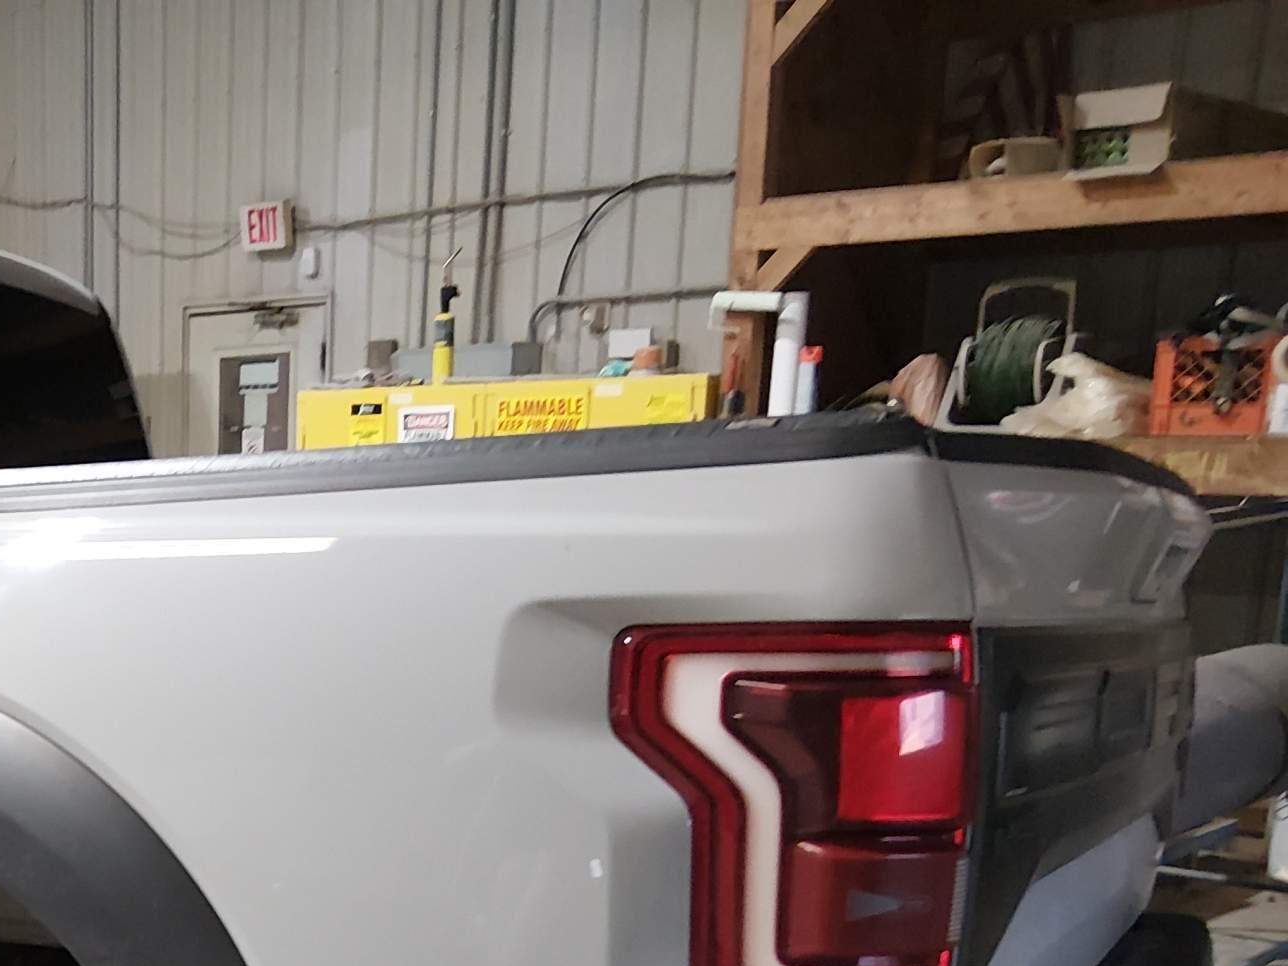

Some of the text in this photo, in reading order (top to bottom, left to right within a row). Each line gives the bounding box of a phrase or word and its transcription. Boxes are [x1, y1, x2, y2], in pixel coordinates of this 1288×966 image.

[247, 205, 278, 244] EXIT
[498, 398, 584, 418] FLAMMABLE
[498, 418, 523, 431] KEEP
